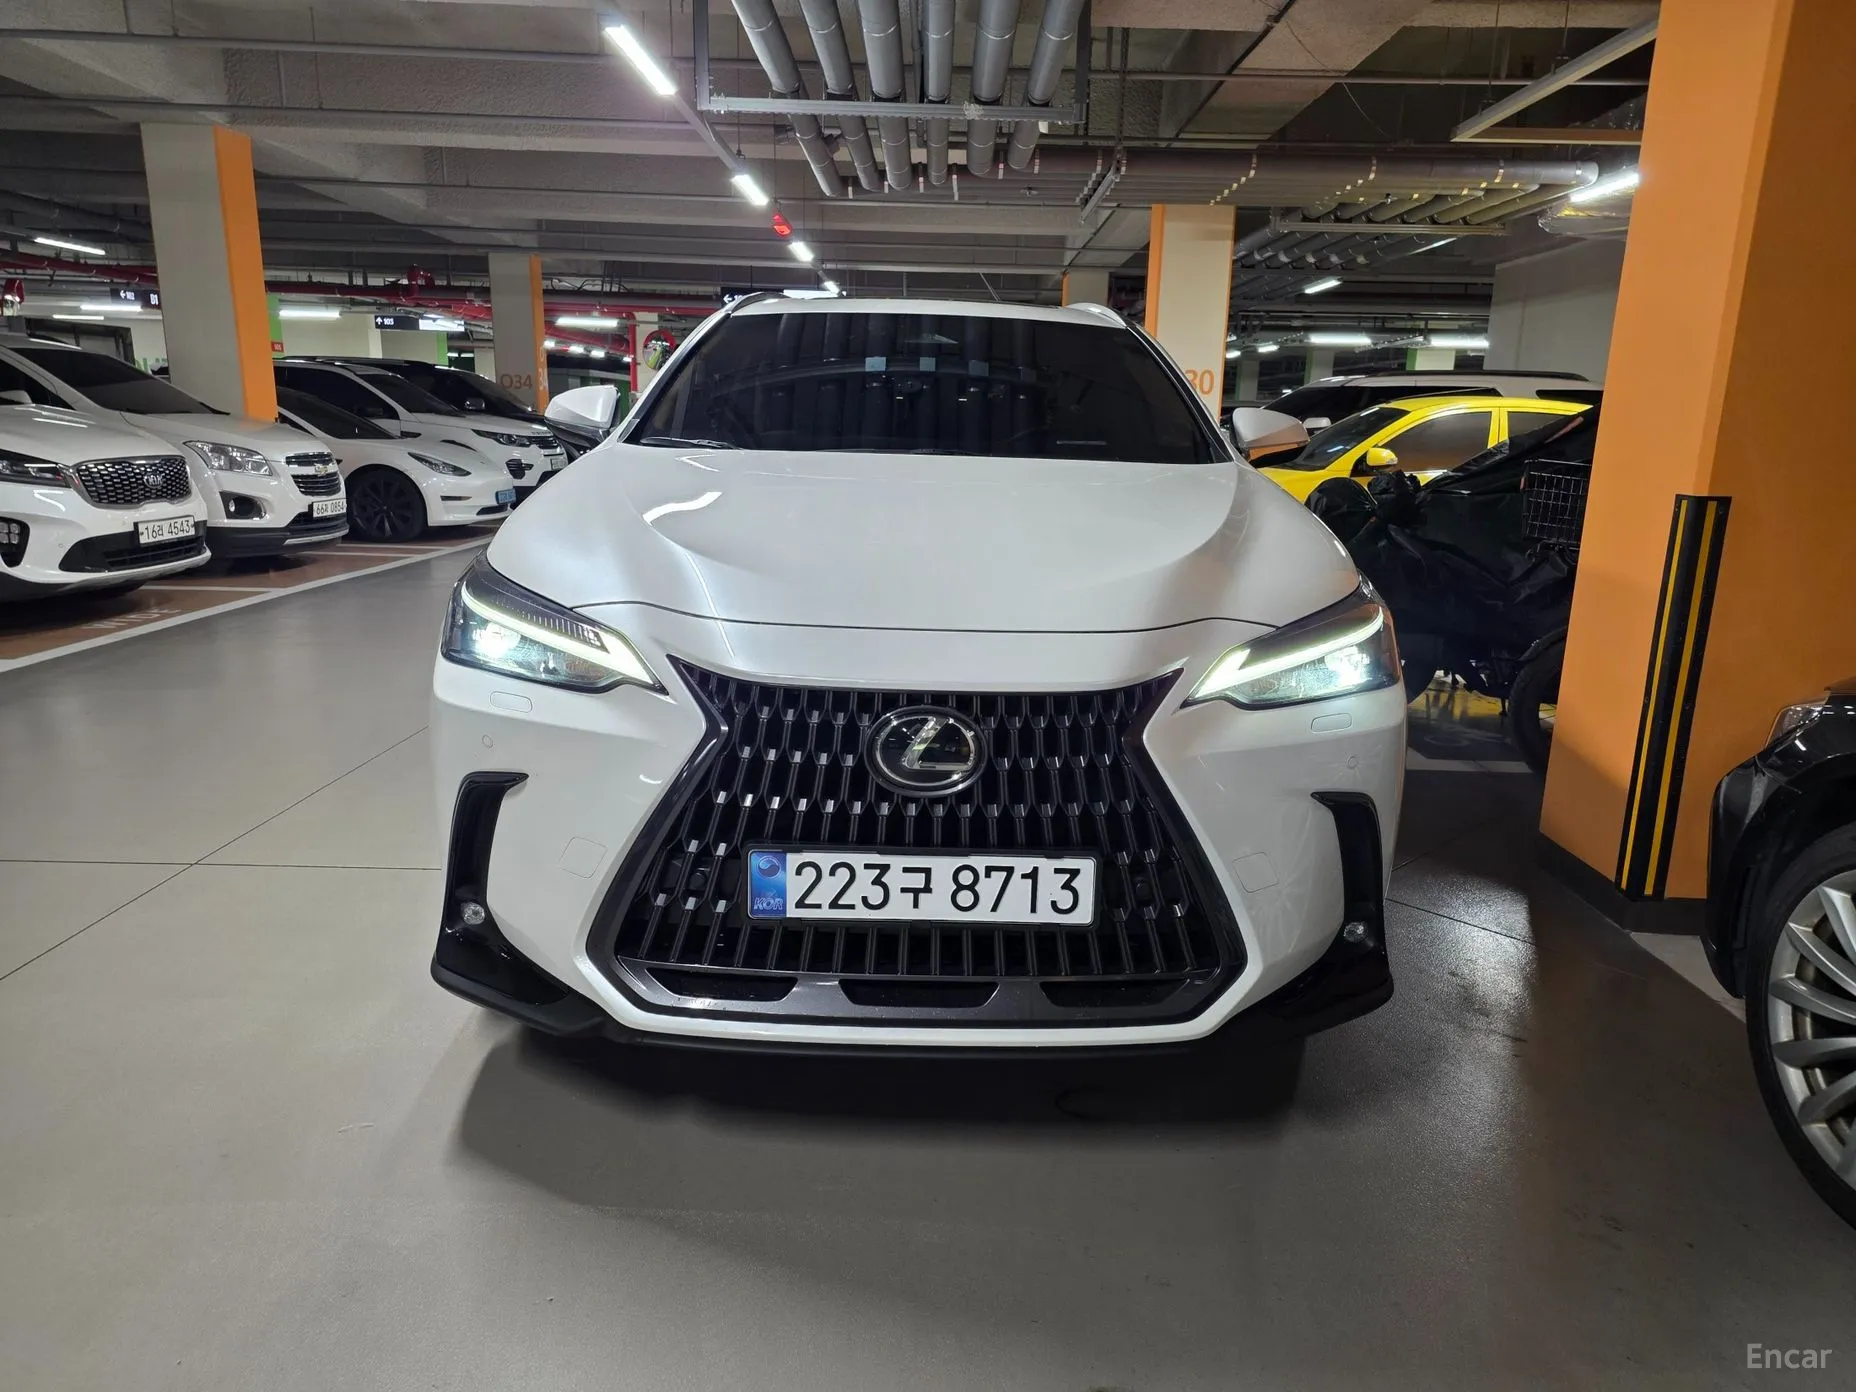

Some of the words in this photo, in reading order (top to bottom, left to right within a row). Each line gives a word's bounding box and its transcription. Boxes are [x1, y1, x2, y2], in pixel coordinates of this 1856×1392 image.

[168, 520, 190, 536] 4543
[794, 860, 933, 910] 223구
[950, 864, 1081, 915] 8713
[753, 897, 784, 910] KOR
